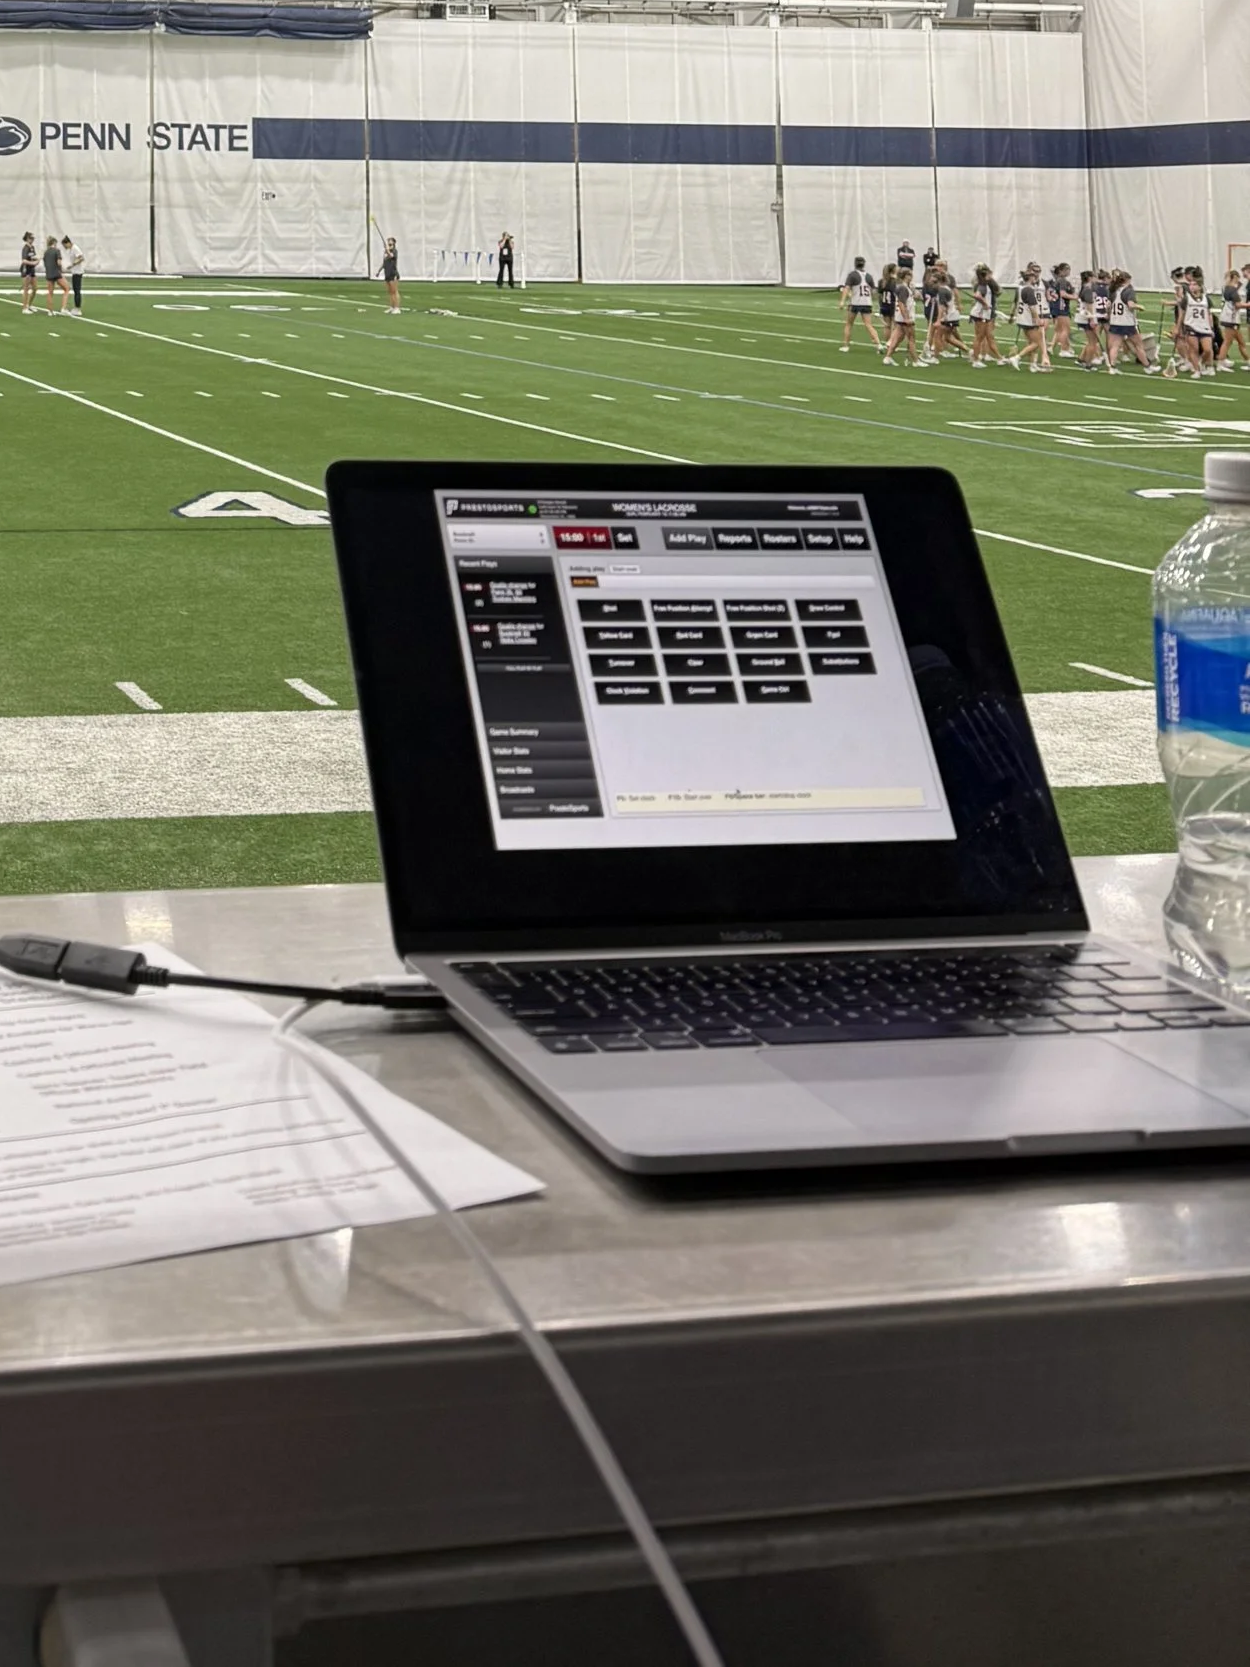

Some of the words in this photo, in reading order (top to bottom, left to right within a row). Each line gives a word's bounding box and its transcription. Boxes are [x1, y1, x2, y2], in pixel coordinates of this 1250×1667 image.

[40, 122, 131, 151] PENN
[146, 122, 249, 152] STATE
[1112, 302, 1125, 316] 19
[1192, 308, 1205, 320] 24
[652, 502, 697, 513] LACROSSE
[669, 532, 686, 543] Add
[687, 532, 707, 545] Play
[718, 533, 753, 545] Reports
[763, 534, 797, 544] Rosters
[807, 534, 833, 546] Setup
[844, 534, 865, 545] Help
